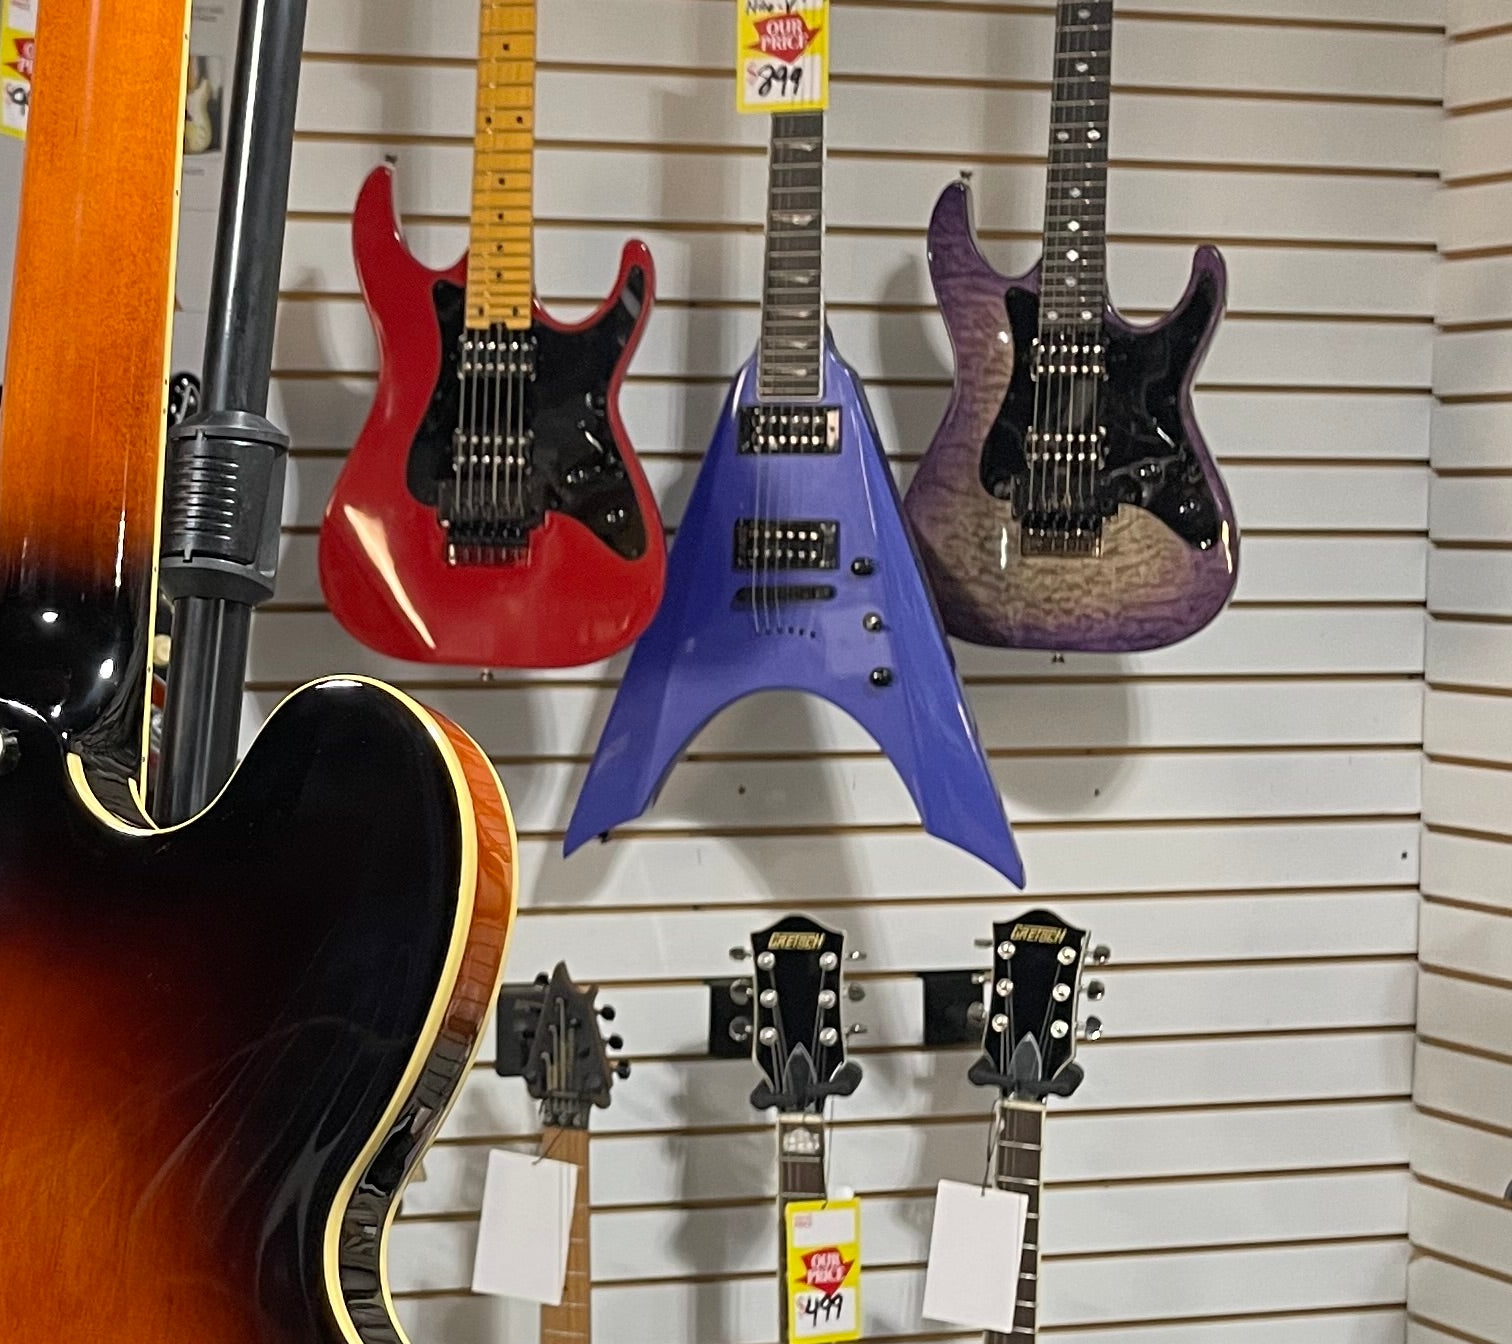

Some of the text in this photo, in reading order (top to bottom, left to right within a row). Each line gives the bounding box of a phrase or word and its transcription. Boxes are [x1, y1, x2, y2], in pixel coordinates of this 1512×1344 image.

[766, 18, 803, 36] OUR
[761, 32, 809, 51] PRICE
[767, 930, 826, 951] GRETSCH
[1011, 923, 1068, 944] GRETSCH
[811, 1253, 841, 1269] OUR
